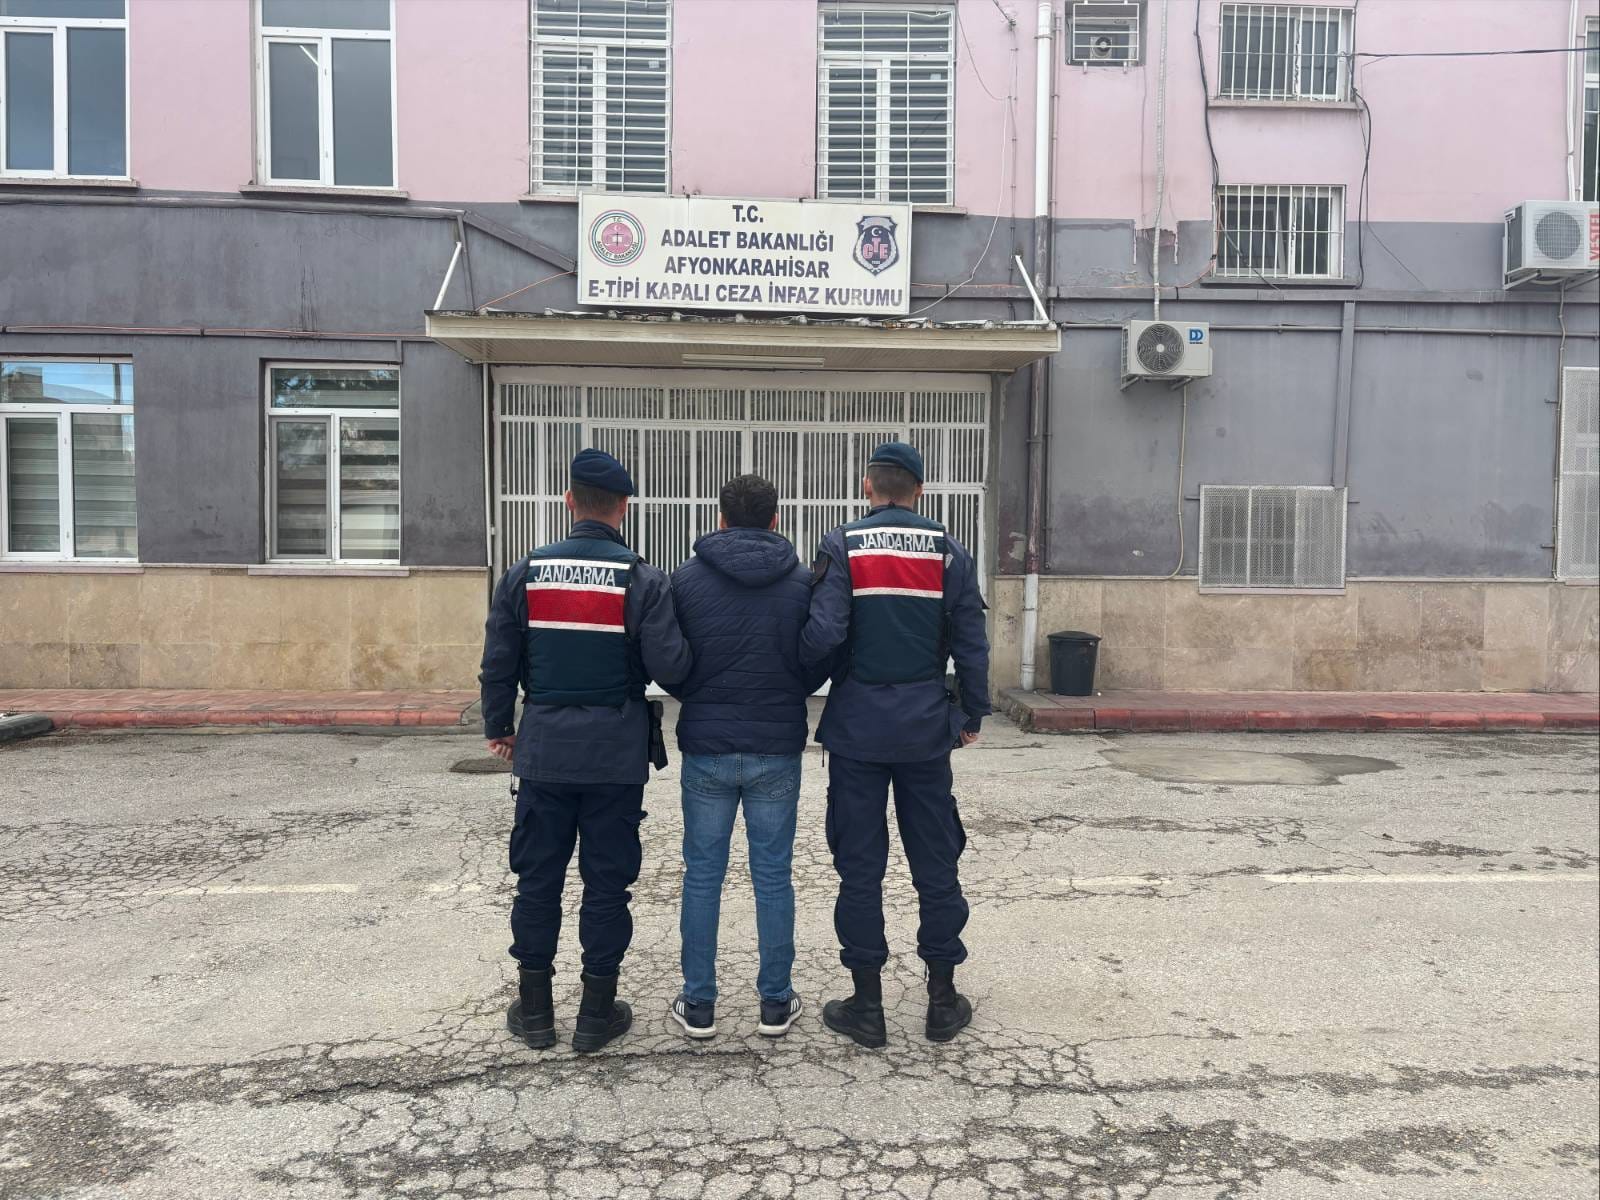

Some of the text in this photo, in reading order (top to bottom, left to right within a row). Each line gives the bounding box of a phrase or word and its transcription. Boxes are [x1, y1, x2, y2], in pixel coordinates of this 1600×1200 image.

[732, 205, 764, 223] T.C.
[661, 229, 834, 252] ADALET BAKANLIĞI
[664, 256, 830, 278] AFYONKARAHİSAR
[588, 276, 903, 307] E-TİPİ KAPALI CEZA İNFAZ KURUMU
[859, 533, 936, 553] JANDARMA
[535, 565, 616, 587] JANDARMA
